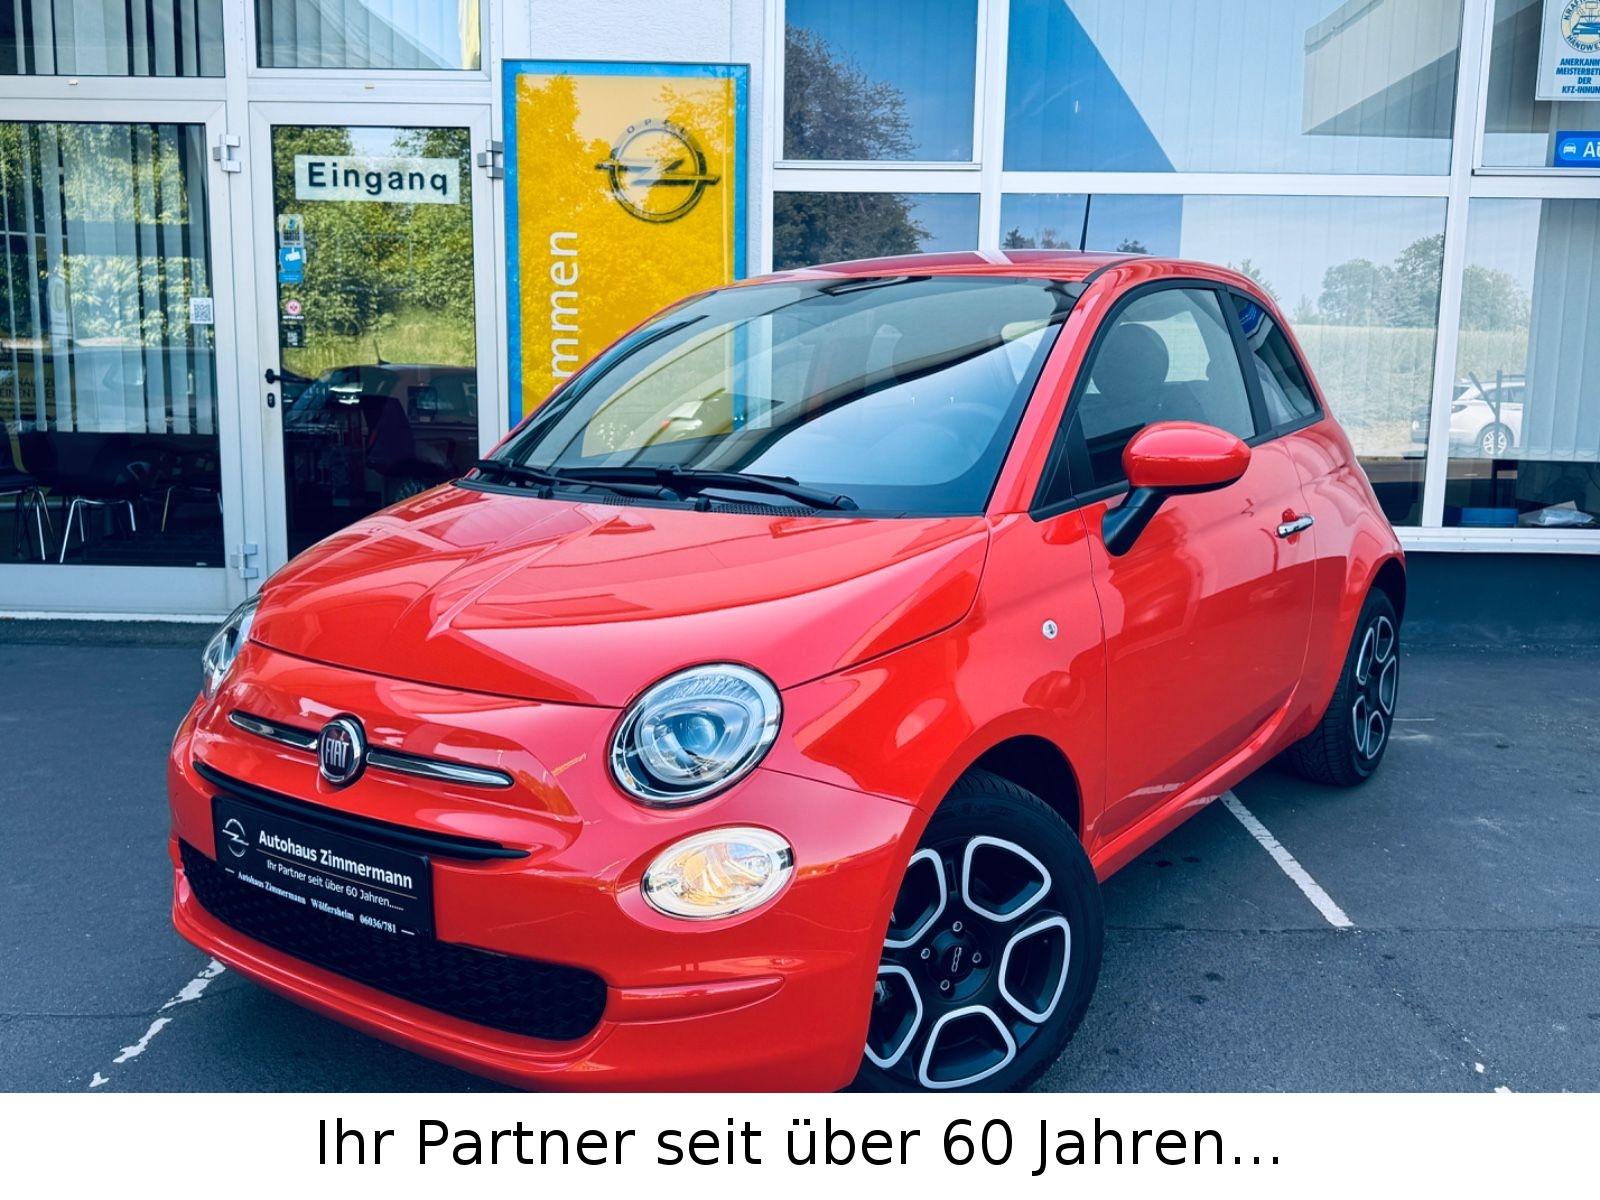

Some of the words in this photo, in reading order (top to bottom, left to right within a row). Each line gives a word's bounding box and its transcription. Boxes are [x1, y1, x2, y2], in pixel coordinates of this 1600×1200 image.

[1559, 58, 1600, 66] ANERKANN
[549, 230, 579, 386] mmen
[325, 737, 350, 768] FIAT
[259, 830, 317, 862] Autohaus
[319, 849, 413, 889] Zimmermann
[265, 881, 306, 905] Zimmermann
[267, 859, 277, 871] Ihr
[278, 863, 307, 881] Partner
[307, 874, 324, 887] seit
[324, 878, 344, 893] über
[345, 885, 358, 898] 60
